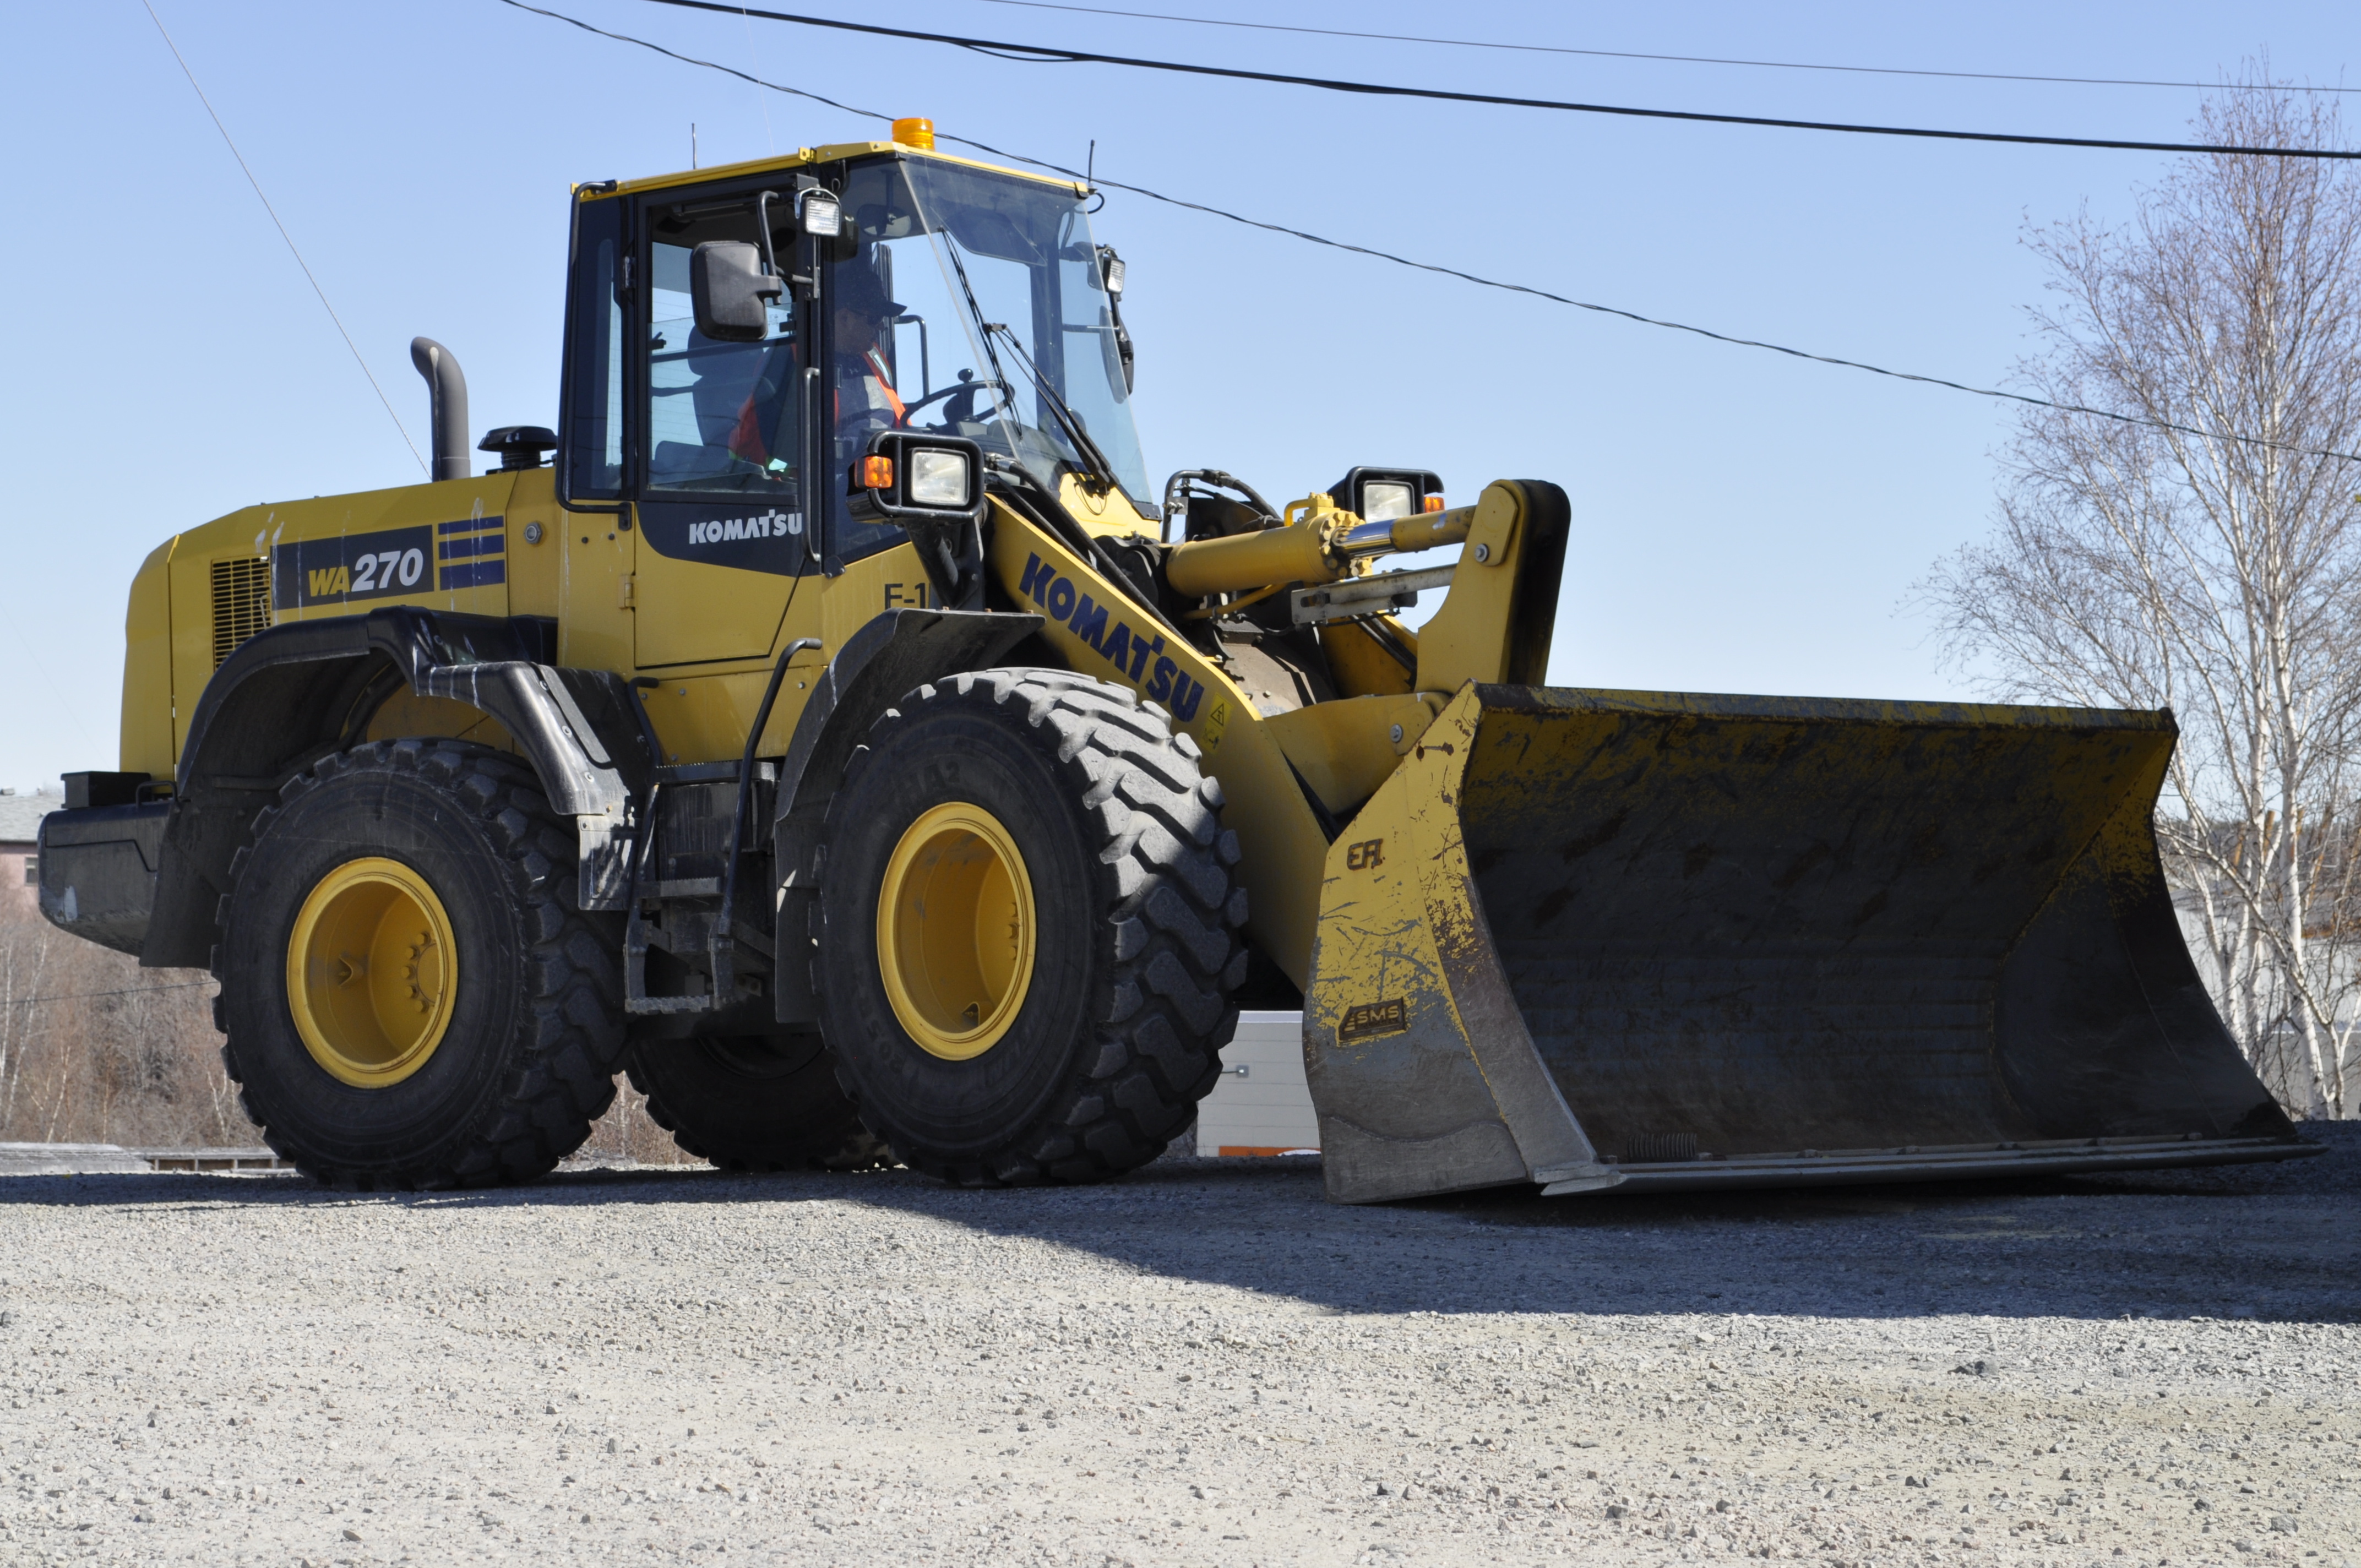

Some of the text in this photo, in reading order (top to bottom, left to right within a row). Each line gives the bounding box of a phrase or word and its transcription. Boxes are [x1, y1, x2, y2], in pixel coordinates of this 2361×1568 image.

[689, 509, 802, 545] KOMATSU
[308, 548, 423, 597] WA270
[1019, 552, 1205, 723] KOMATSU
[1357, 1005, 1399, 1024] SMS
